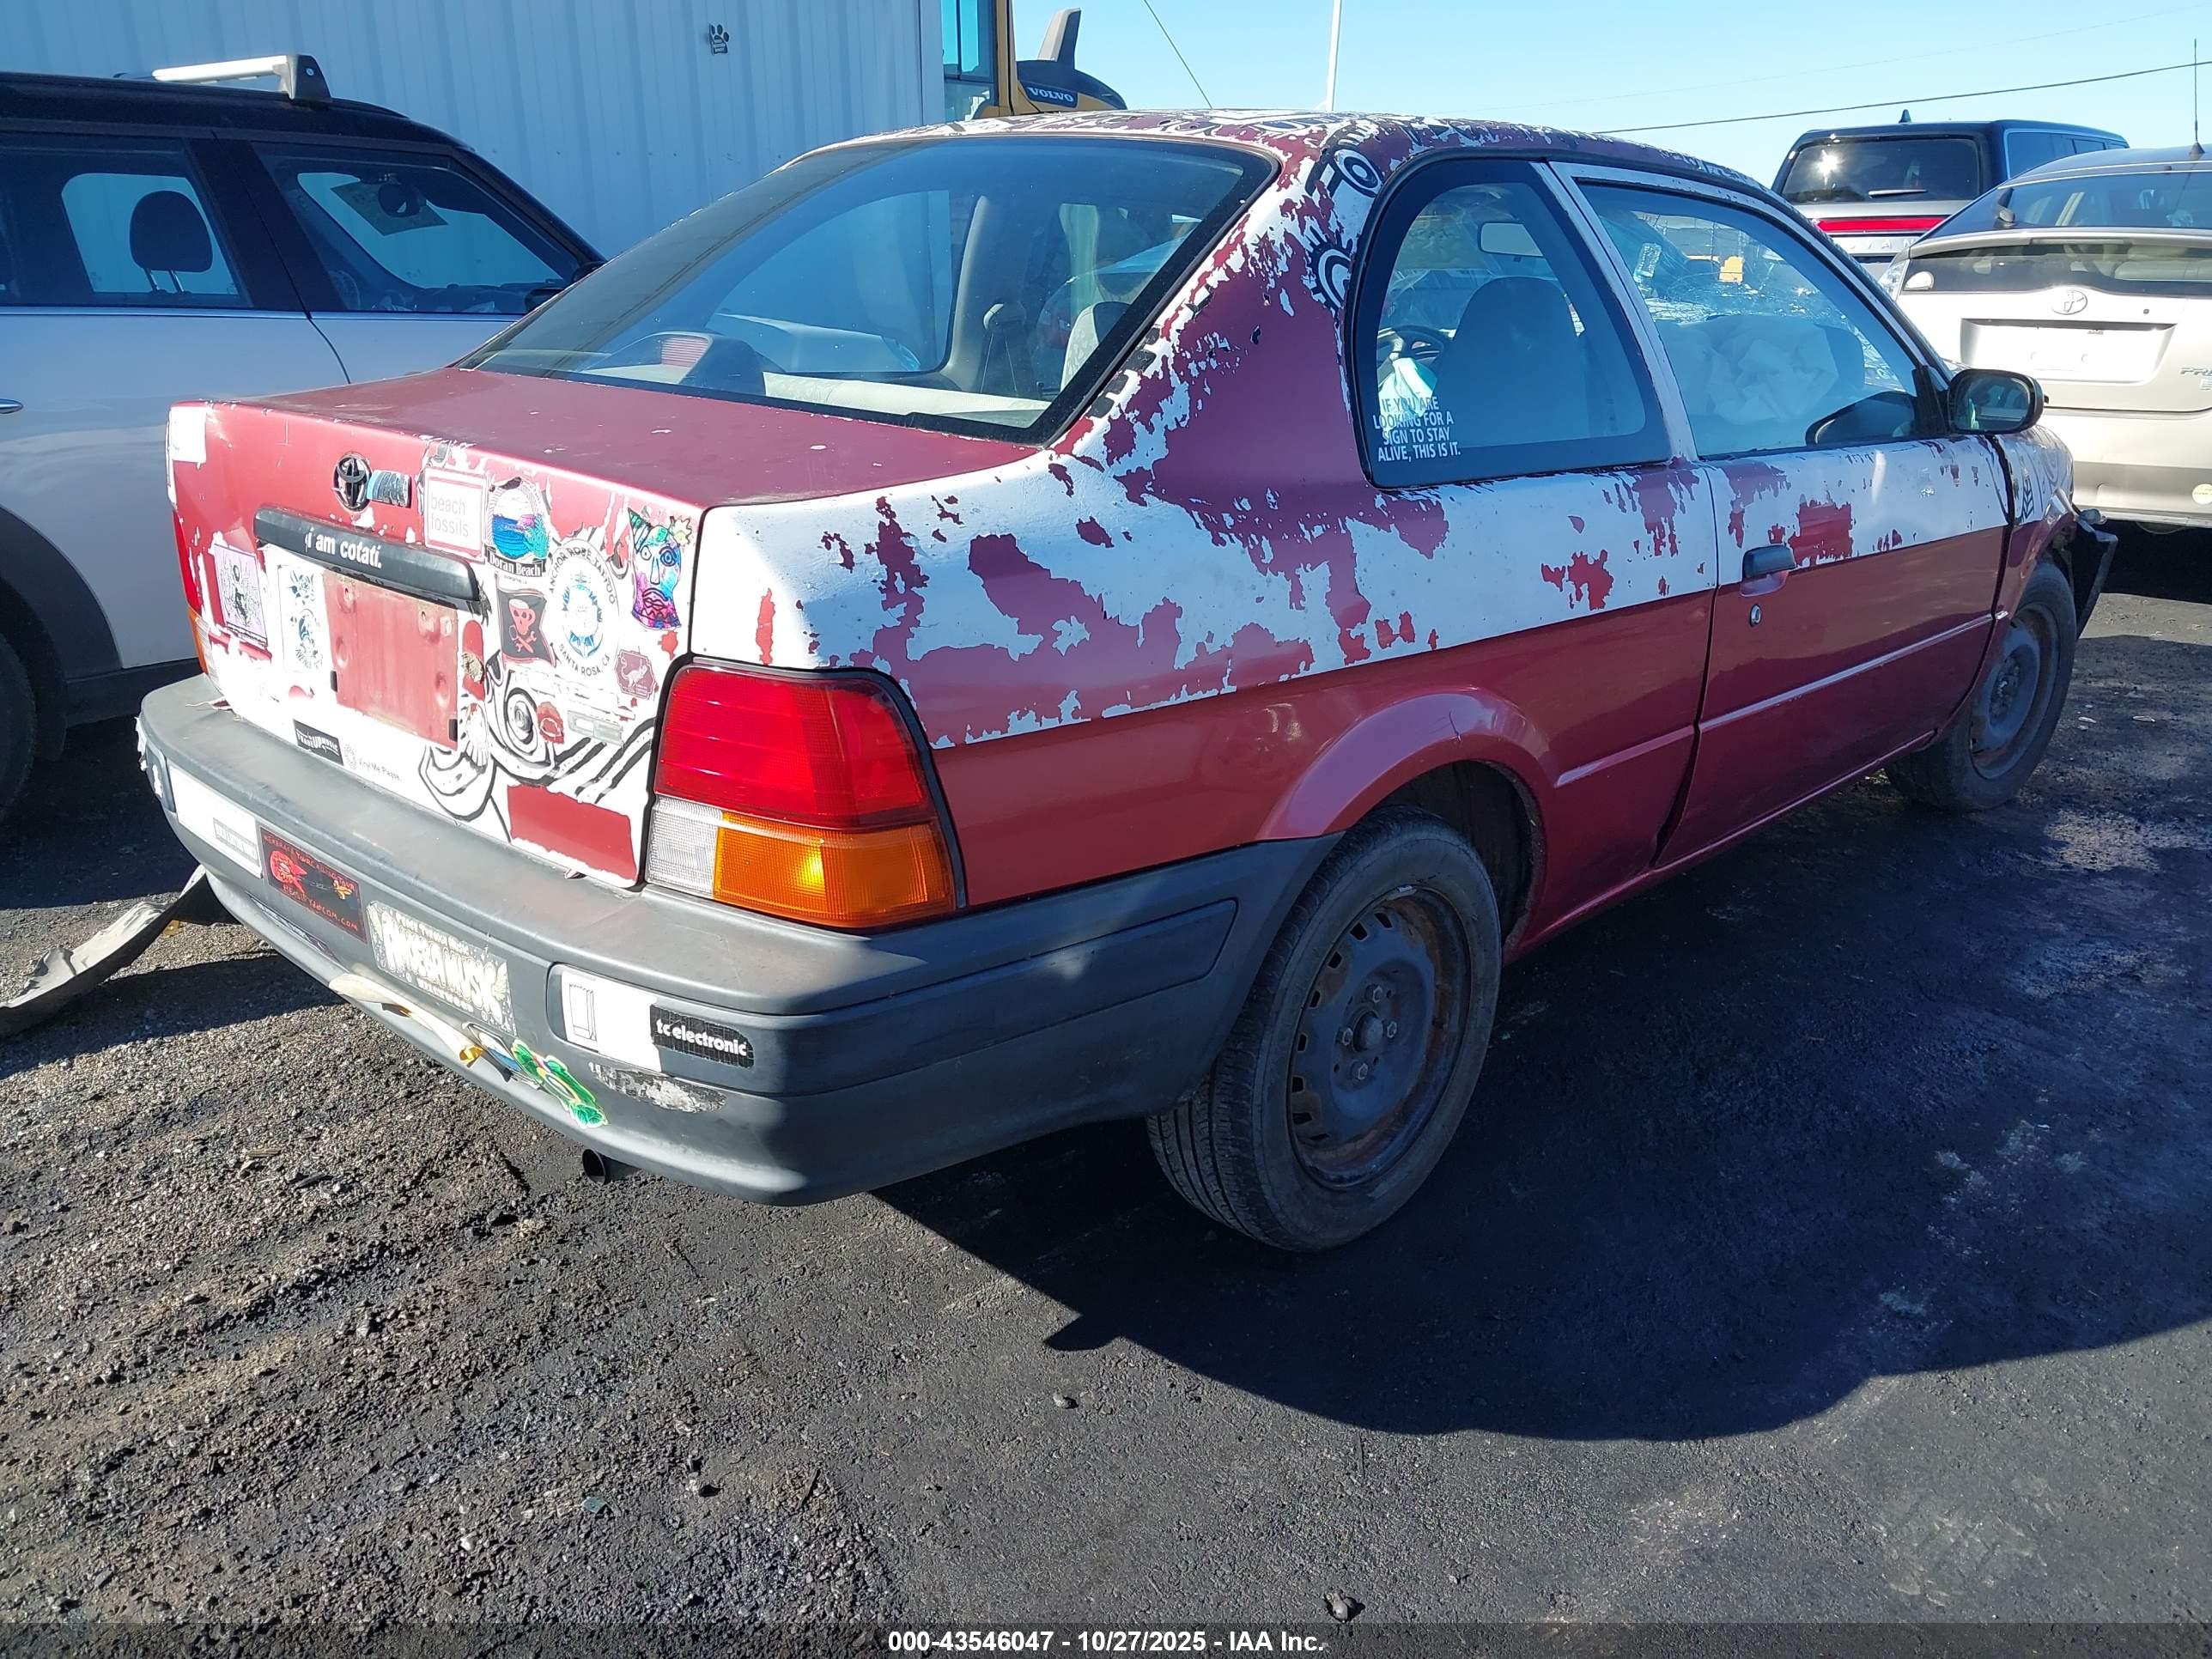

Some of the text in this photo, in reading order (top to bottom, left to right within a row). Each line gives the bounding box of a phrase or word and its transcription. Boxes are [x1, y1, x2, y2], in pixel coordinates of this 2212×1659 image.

[1026, 86, 1074, 102] VOLVO
[1382, 396, 1440, 412] IF YOU ARE
[1372, 410, 1455, 429] LOOKING FOR A
[1382, 427, 1450, 446] SIGN TO STAY
[1378, 441, 1462, 463] ALIVE, THIS IS IT.
[430, 492, 466, 515] beach
[430, 512, 470, 538] fossils
[315, 533, 336, 556] am
[339, 541, 382, 569] cotati.
[515, 561, 542, 577] Beach
[549, 551, 568, 593] ANCHOR
[558, 643, 579, 672] SANTA
[601, 653, 611, 666] CA
